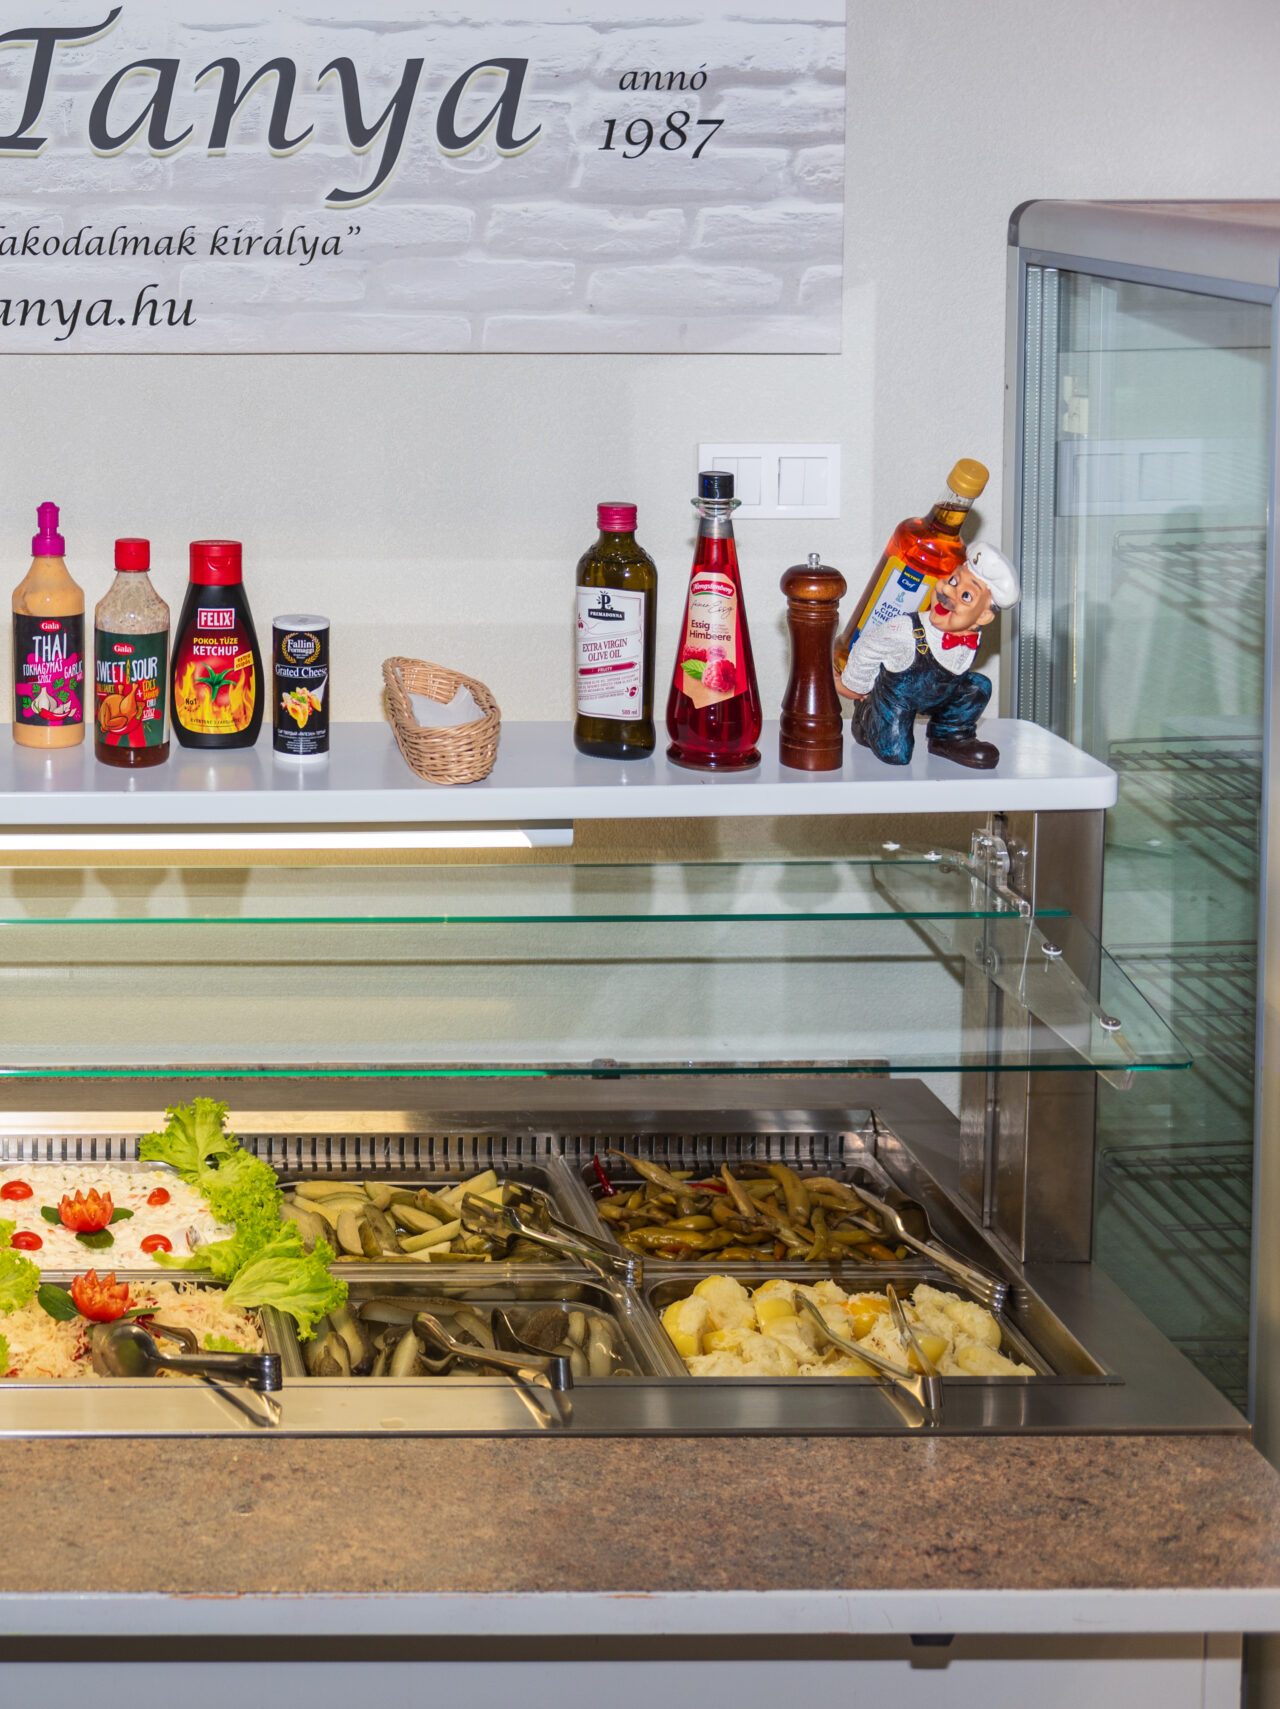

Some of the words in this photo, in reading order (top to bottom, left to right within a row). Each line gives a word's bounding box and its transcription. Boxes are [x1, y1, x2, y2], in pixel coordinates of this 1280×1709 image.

[619, 64, 708, 91] annó
[599, 111, 725, 159] 1987
[201, 612, 231, 626] FELIX
[691, 620, 710, 631] Essig
[193, 637, 219, 645] POKOL
[689, 630, 732, 641] Himbeere
[114, 645, 133, 653] Gala
[193, 645, 239, 656] KETCHUP
[288, 639, 315, 650] Fallini
[582, 642, 603, 653] EXTRA
[603, 638, 628, 650] VIRGIN
[588, 651, 609, 662] OLIVE
[609, 649, 622, 659] OIL
[96, 660, 126, 683] SWEET
[131, 656, 158, 682] SOUR
